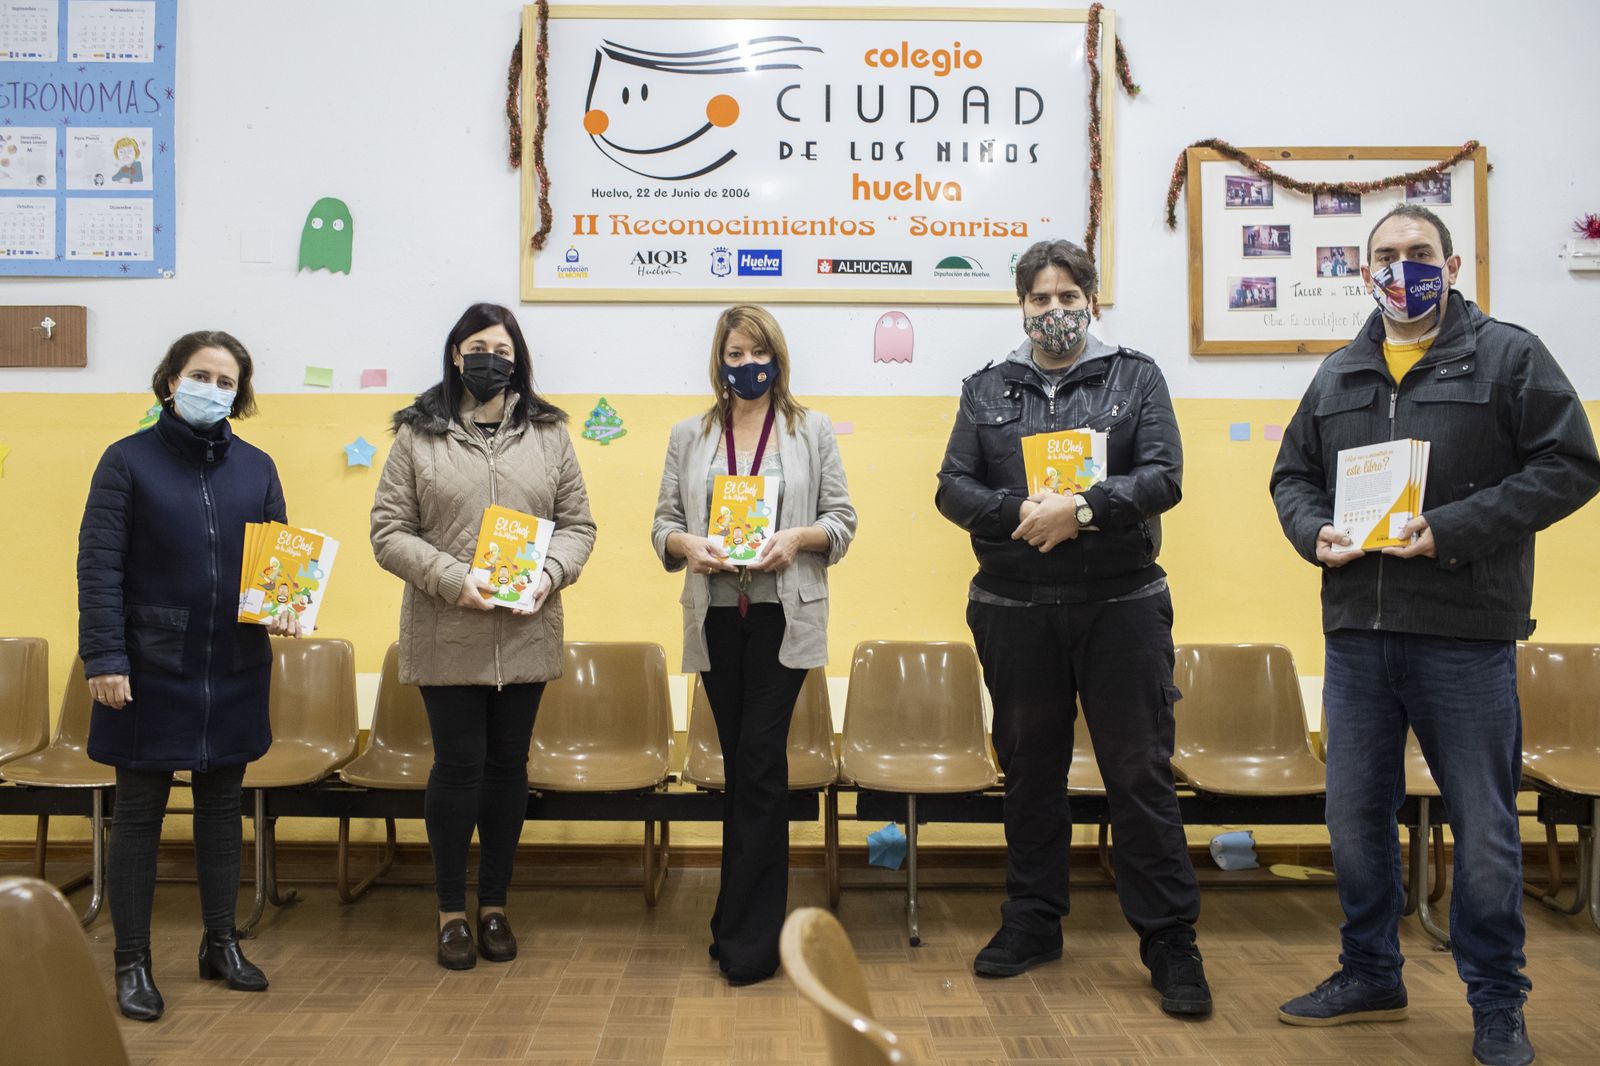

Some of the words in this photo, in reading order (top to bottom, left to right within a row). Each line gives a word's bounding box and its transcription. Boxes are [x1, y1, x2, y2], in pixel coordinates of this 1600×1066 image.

[864, 41, 982, 76] colegio
[776, 84, 1044, 125] CIUDAD
[779, 141, 817, 160] DE
[850, 141, 906, 161] LOS
[937, 139, 1039, 163] NIÑOS
[591, 188, 632, 199] Huelva,
[636, 188, 650, 198] 22
[654, 188, 668, 198] de
[671, 188, 700, 198] Junio
[704, 188, 718, 198] de
[721, 188, 750, 198] 2006
[852, 173, 962, 201] huelva
[572, 214, 599, 235] II
[608, 214, 876, 236] Reconocimientos
[909, 215, 1029, 237] Sonrisa
[630, 250, 688, 268] AIQB
[741, 254, 780, 267] Huelva
[838, 261, 908, 273] ALHUCEMA
[637, 265, 682, 277] Huelva
[1290, 282, 1322, 297] TALLER
[1047, 438, 1060, 454] El
[1061, 438, 1084, 457] Chef
[724, 480, 736, 494] El
[737, 481, 757, 498] Chef
[495, 516, 507, 531] El
[508, 520, 529, 539] Chef
[277, 530, 291, 546] El
[291, 534, 314, 556] Chef
